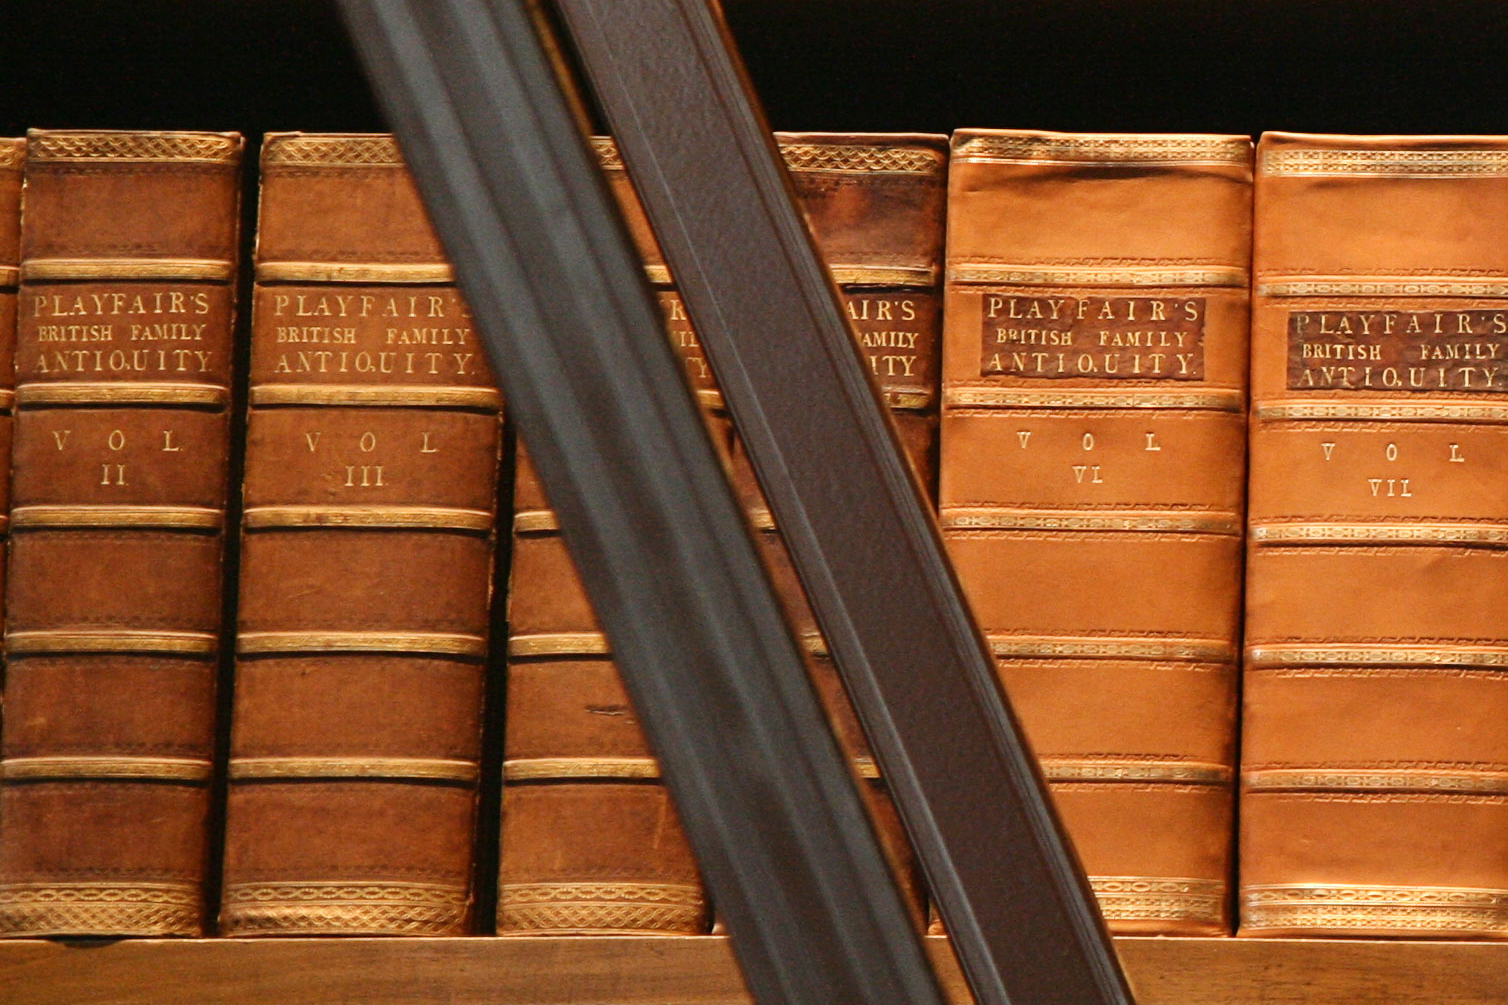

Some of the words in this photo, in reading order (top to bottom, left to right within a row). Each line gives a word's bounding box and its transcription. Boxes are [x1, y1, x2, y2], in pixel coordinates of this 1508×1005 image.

[34, 292, 210, 317] PLAYFAIR'S
[987, 297, 1198, 321] PLAYFAIR'S
[38, 325, 113, 342] BRITISH
[130, 323, 207, 341] FAMILY
[1297, 313, 1507, 335] PLAYFAIR'S
[277, 327, 356, 344] BRITISH
[386, 327, 471, 345] FAMILY
[996, 328, 1073, 345] BRITISH
[1099, 330, 1188, 347] FAMILY
[1302, 344, 1382, 361] BRITISH
[1420, 343, 1501, 360] FAMILY
